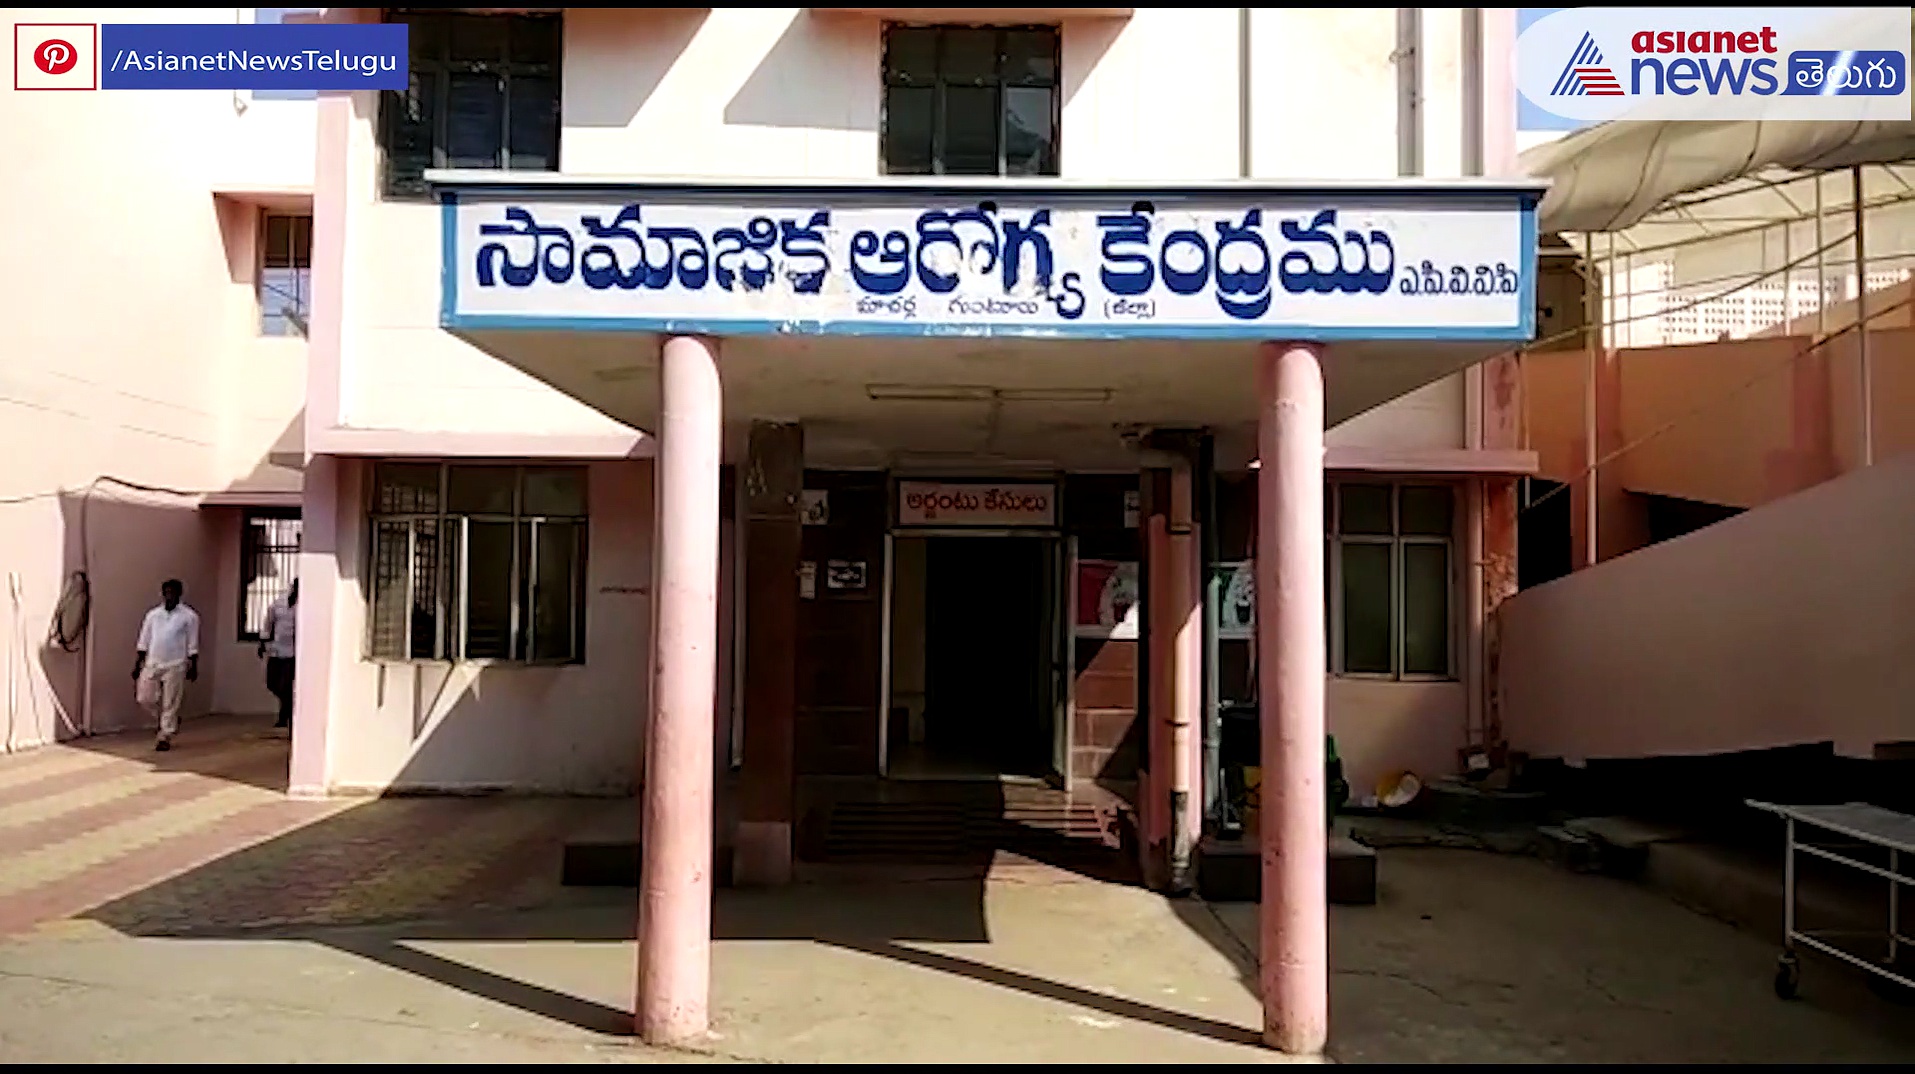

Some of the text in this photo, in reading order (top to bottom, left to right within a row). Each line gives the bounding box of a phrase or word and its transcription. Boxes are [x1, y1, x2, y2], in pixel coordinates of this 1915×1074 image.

[476, 203, 832, 294] సామాజిక
[849, 200, 1087, 319] ఆరోగ్య
[1096, 200, 1395, 319] కేంద్రము
